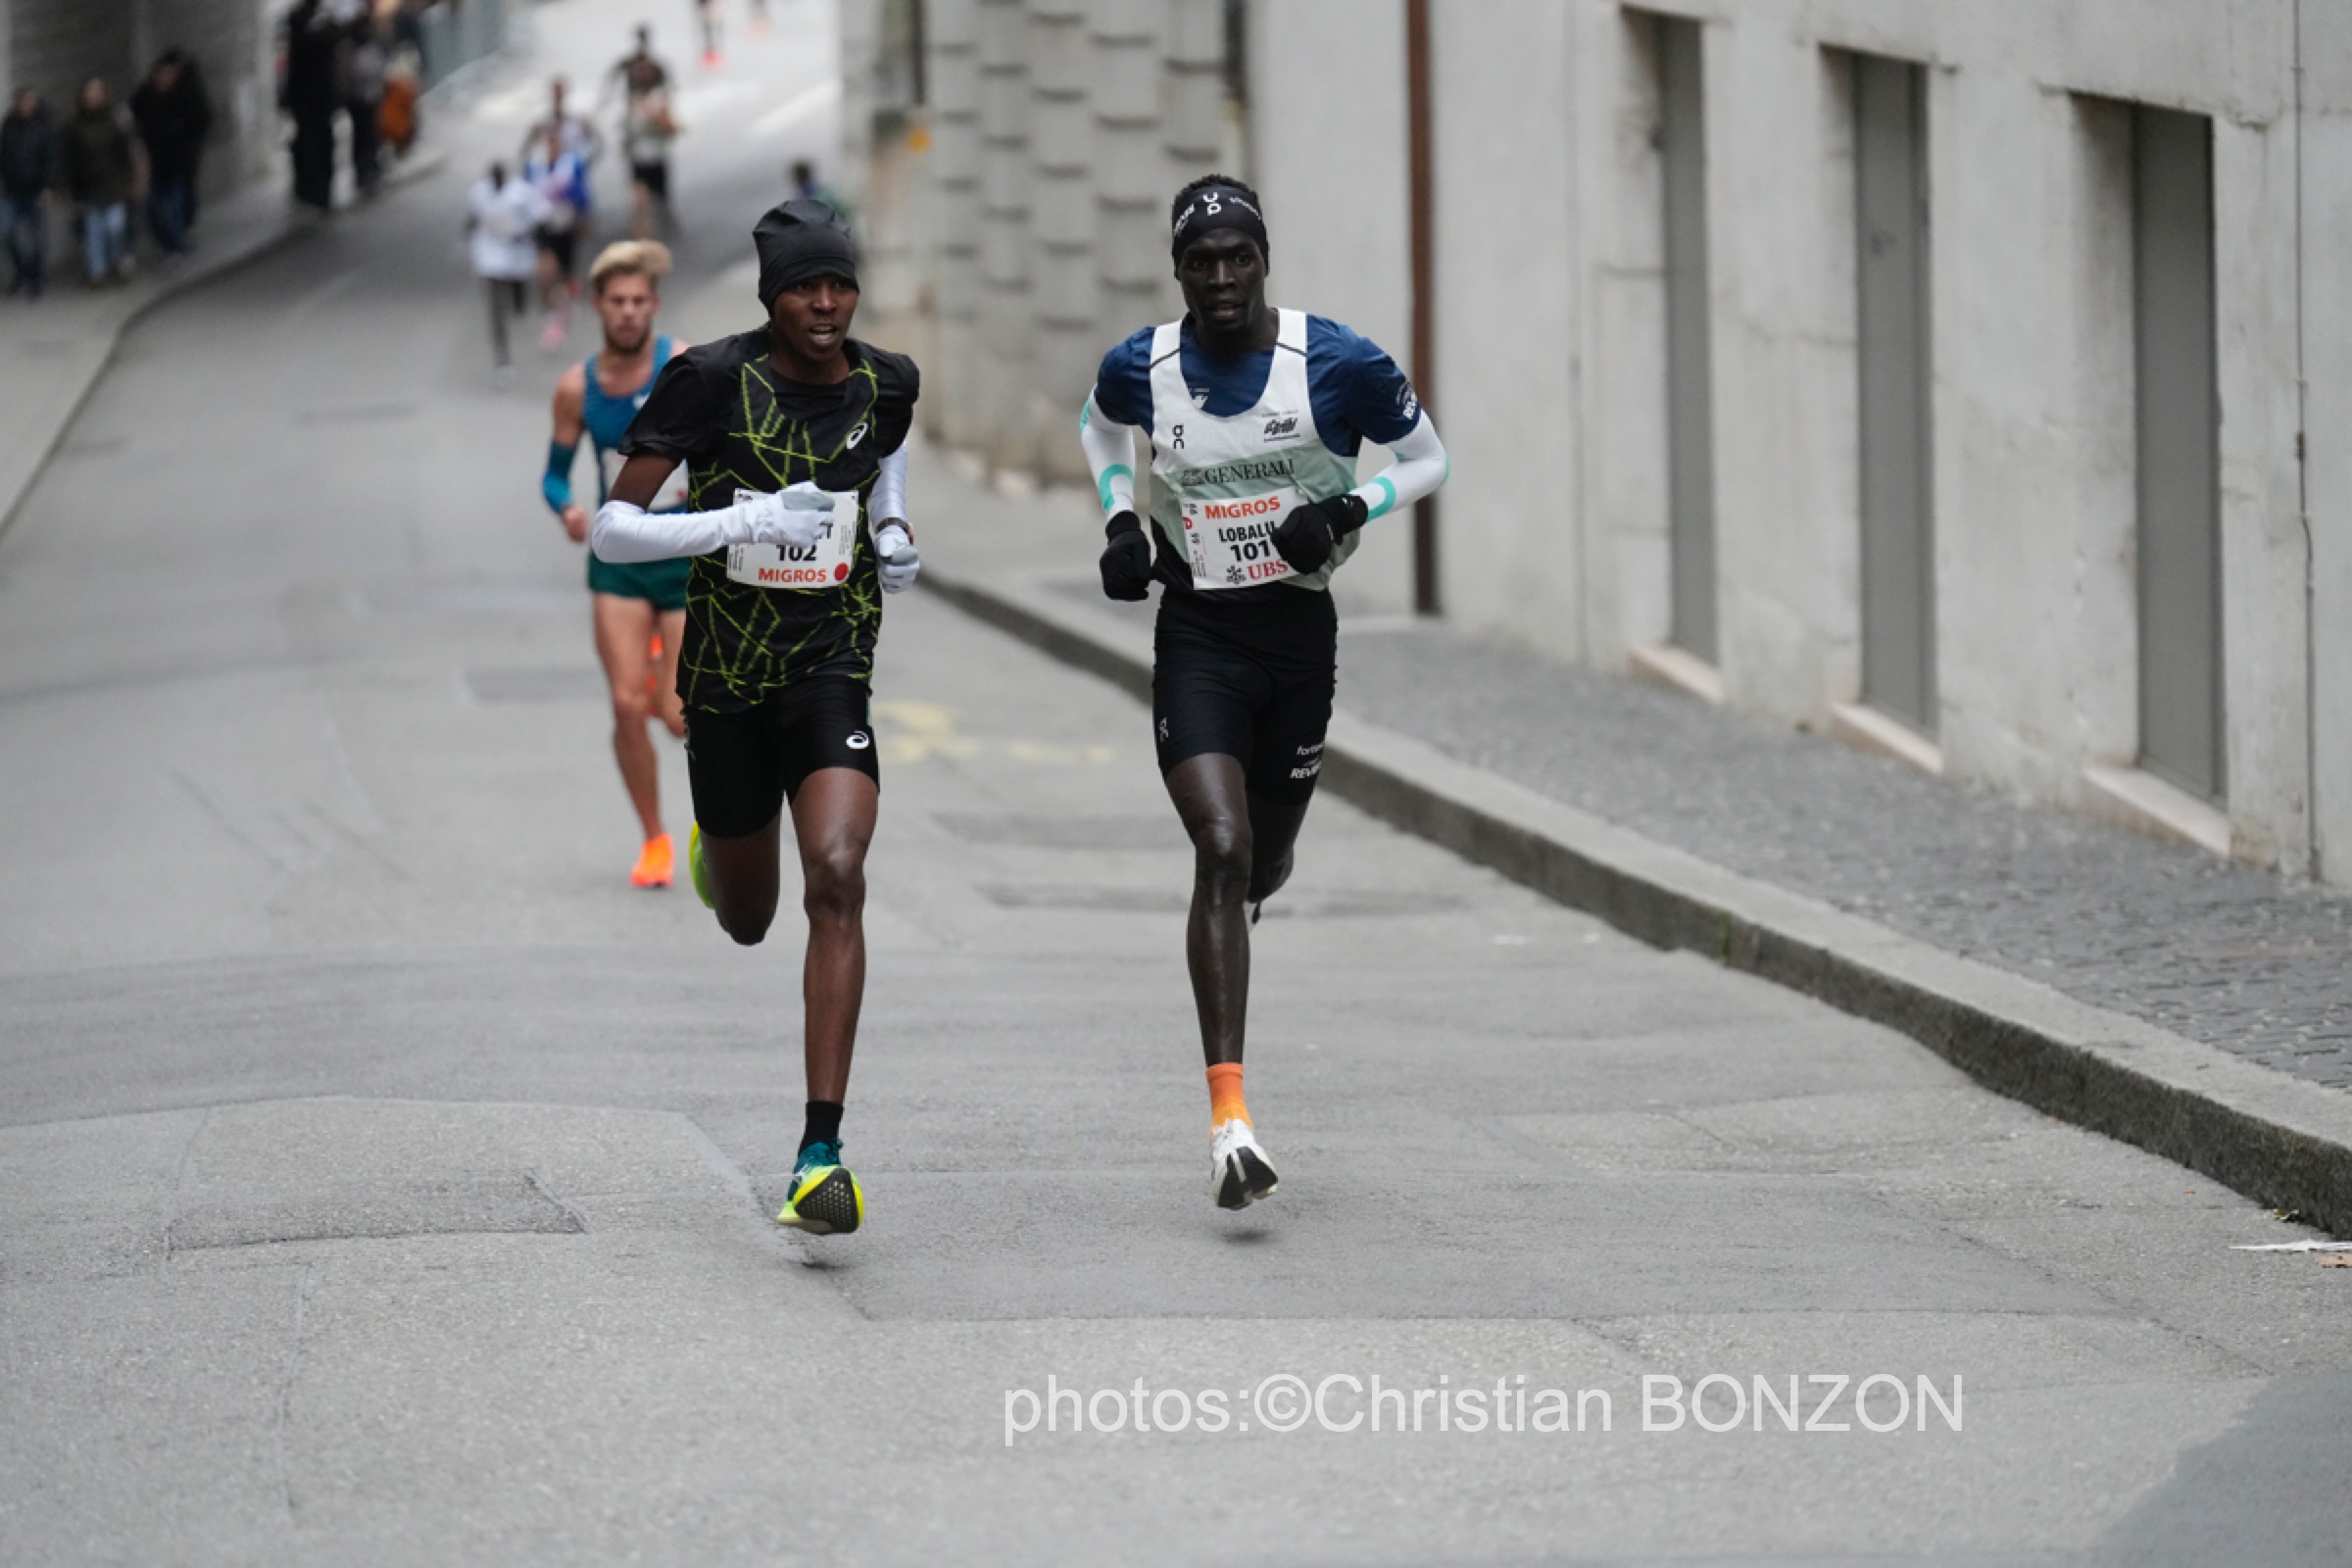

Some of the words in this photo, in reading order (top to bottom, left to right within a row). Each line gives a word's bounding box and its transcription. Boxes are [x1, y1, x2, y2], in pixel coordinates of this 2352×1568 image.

[1204, 458, 1295, 484] GENERALI
[1204, 495, 1281, 520] MIGROS
[775, 544, 818, 562] 102
[1230, 539, 1271, 563] 101
[758, 567, 828, 583] MIGROS
[1247, 559, 1289, 580] UBS
